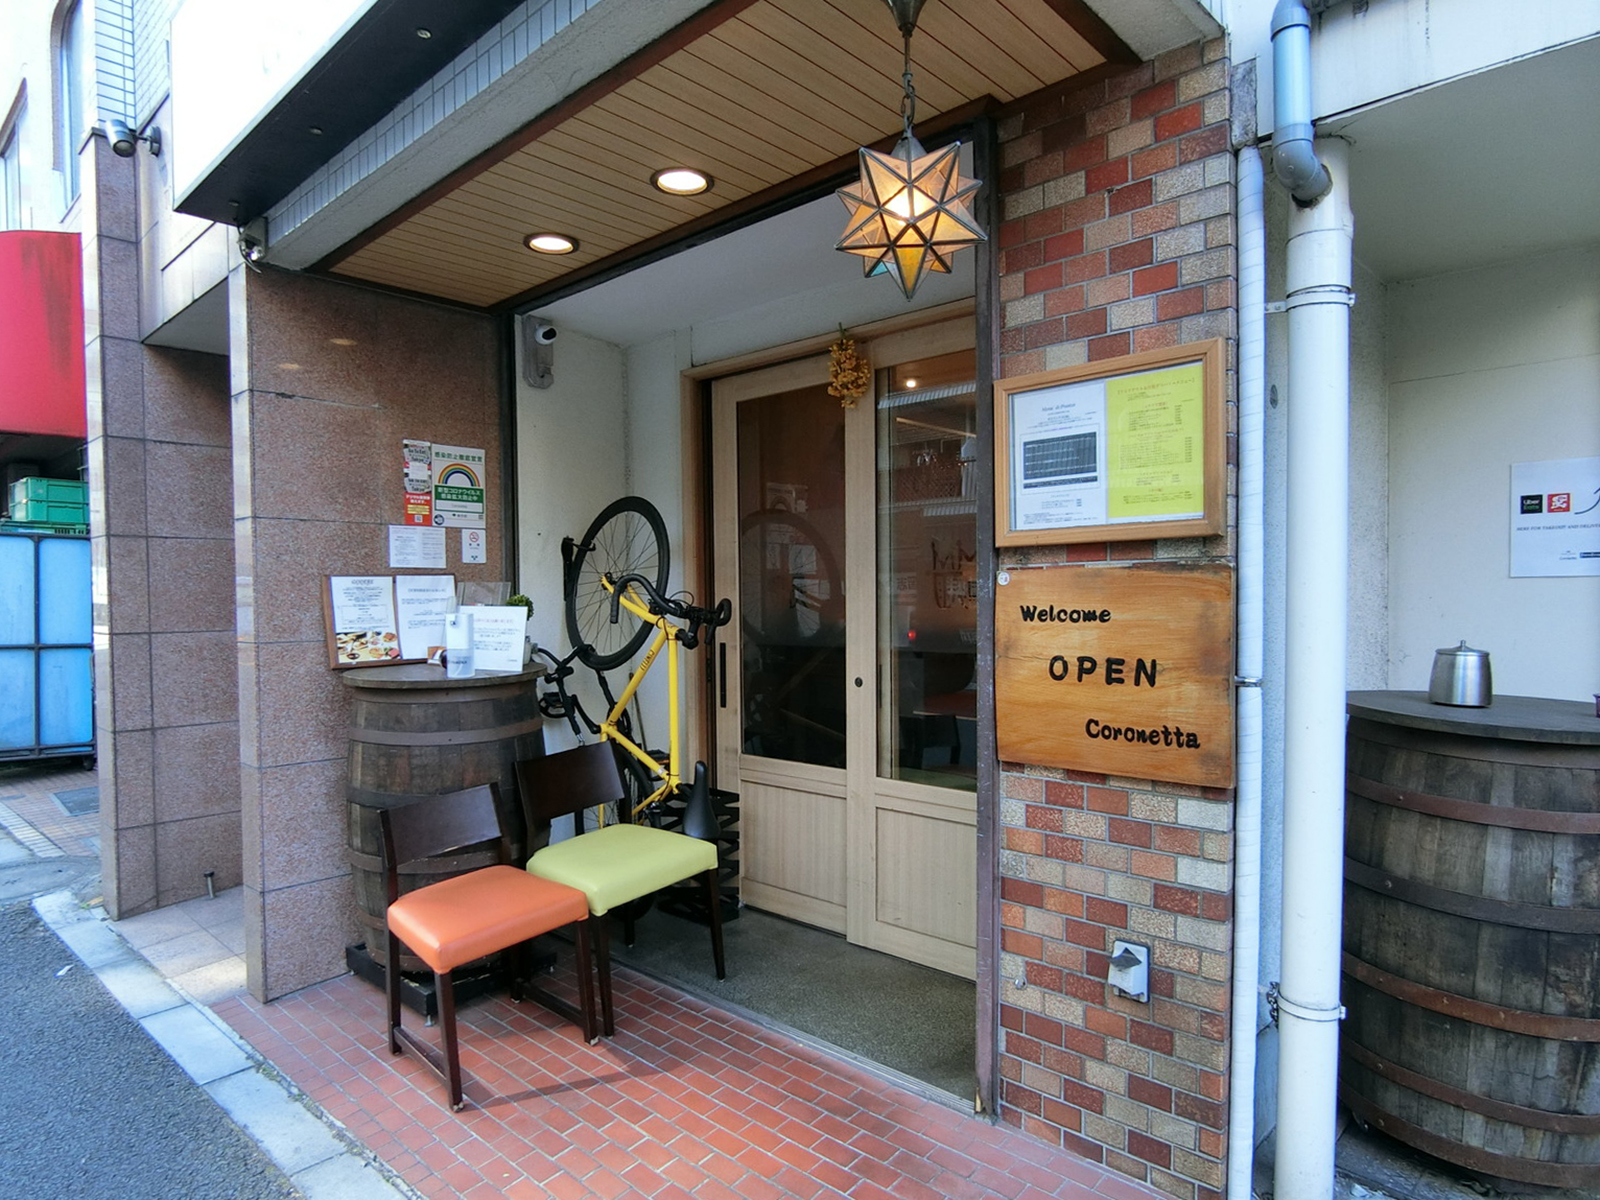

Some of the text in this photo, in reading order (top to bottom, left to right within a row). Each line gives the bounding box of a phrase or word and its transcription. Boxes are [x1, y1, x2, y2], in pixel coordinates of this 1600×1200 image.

[1020, 605, 1112, 623] Welcome
[1049, 655, 1157, 688] OPEN
[1085, 718, 1200, 749] Coronetta
